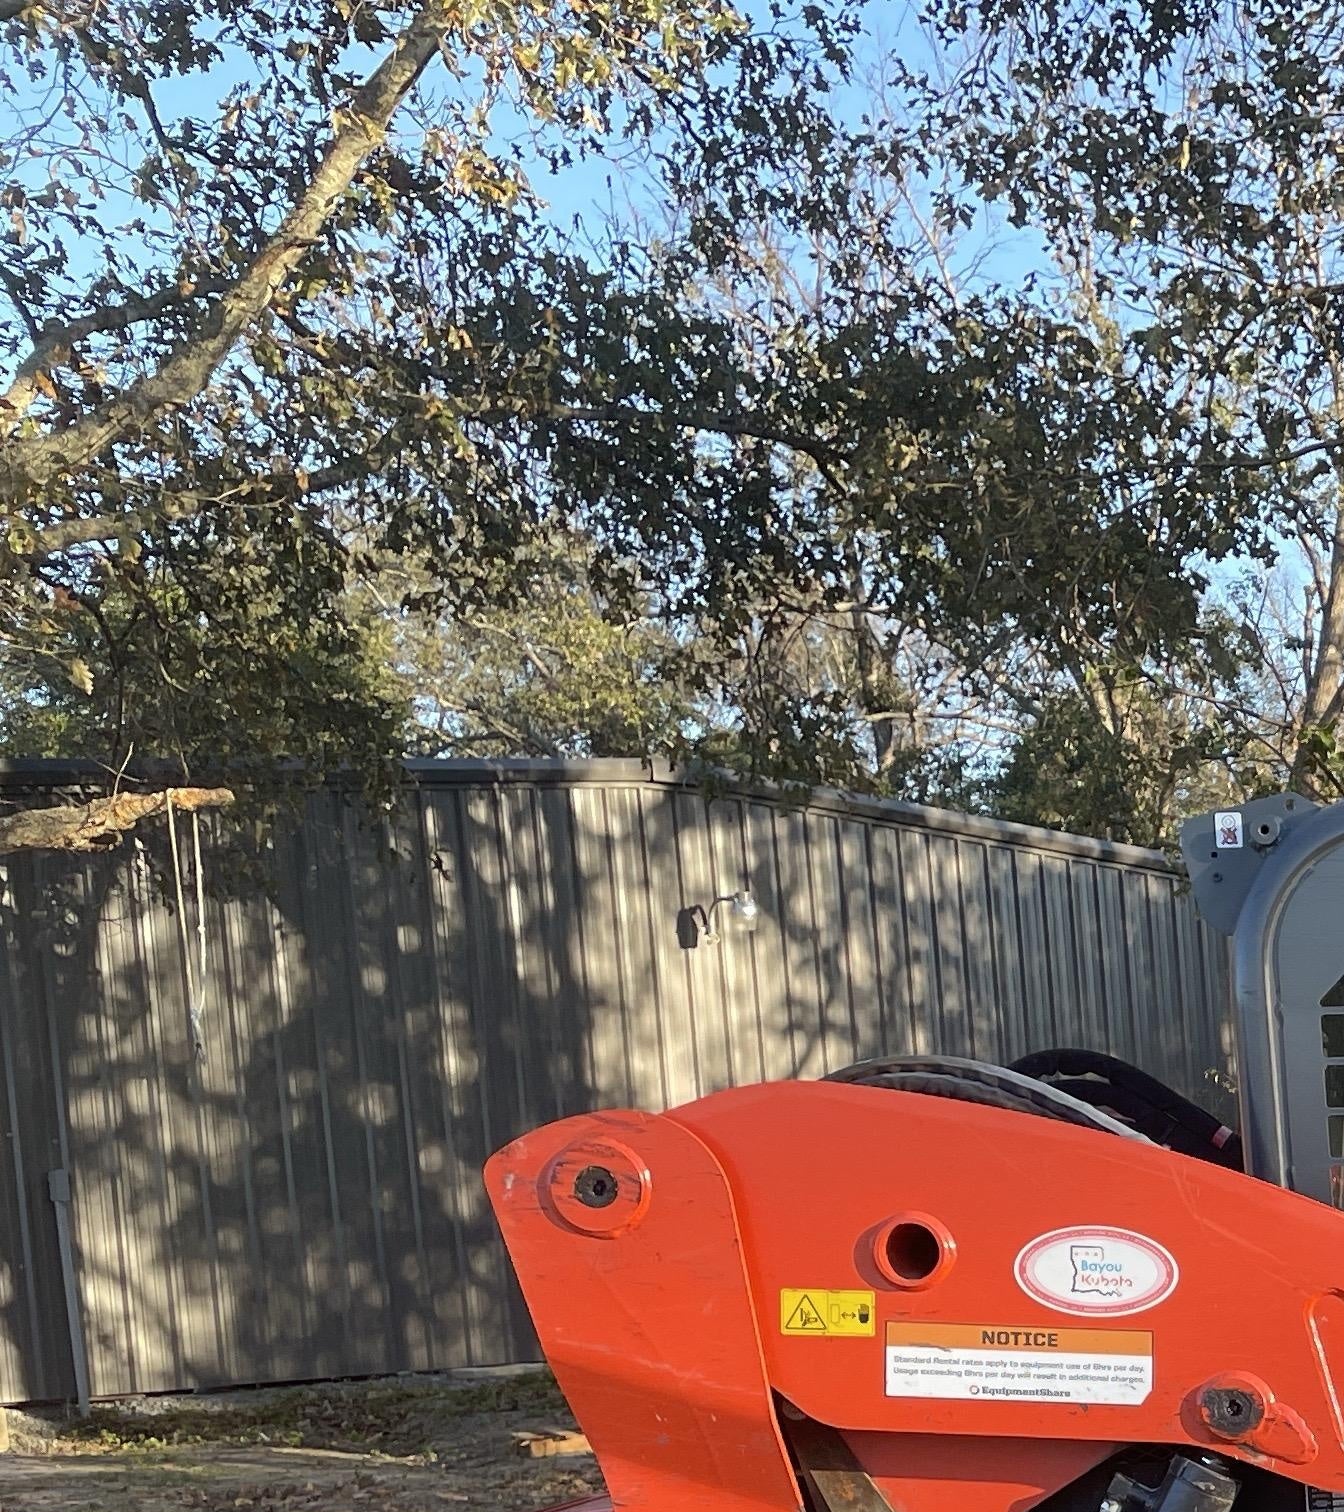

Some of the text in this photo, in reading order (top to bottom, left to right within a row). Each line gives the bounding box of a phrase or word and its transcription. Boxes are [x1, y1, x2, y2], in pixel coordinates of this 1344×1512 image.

[1081, 1259, 1123, 1274] Bayou
[1081, 1274, 1133, 1288] Kubota
[982, 1330, 1059, 1347] NOTICE
[894, 1355, 932, 1364] Standard
[933, 1357, 960, 1365] Rental
[985, 1360, 1008, 1368] apply
[1020, 1361, 1064, 1371] equipment
[1114, 1365, 1128, 1373] per
[893, 1367, 919, 1376] Usage
[920, 1368, 963, 1378] exceeding
[985, 1371, 999, 1379] per
[1000, 1371, 1015, 1380] day
[1068, 1374, 1109, 1382] additional
[981, 1385, 1071, 1397] EquipmentShare
